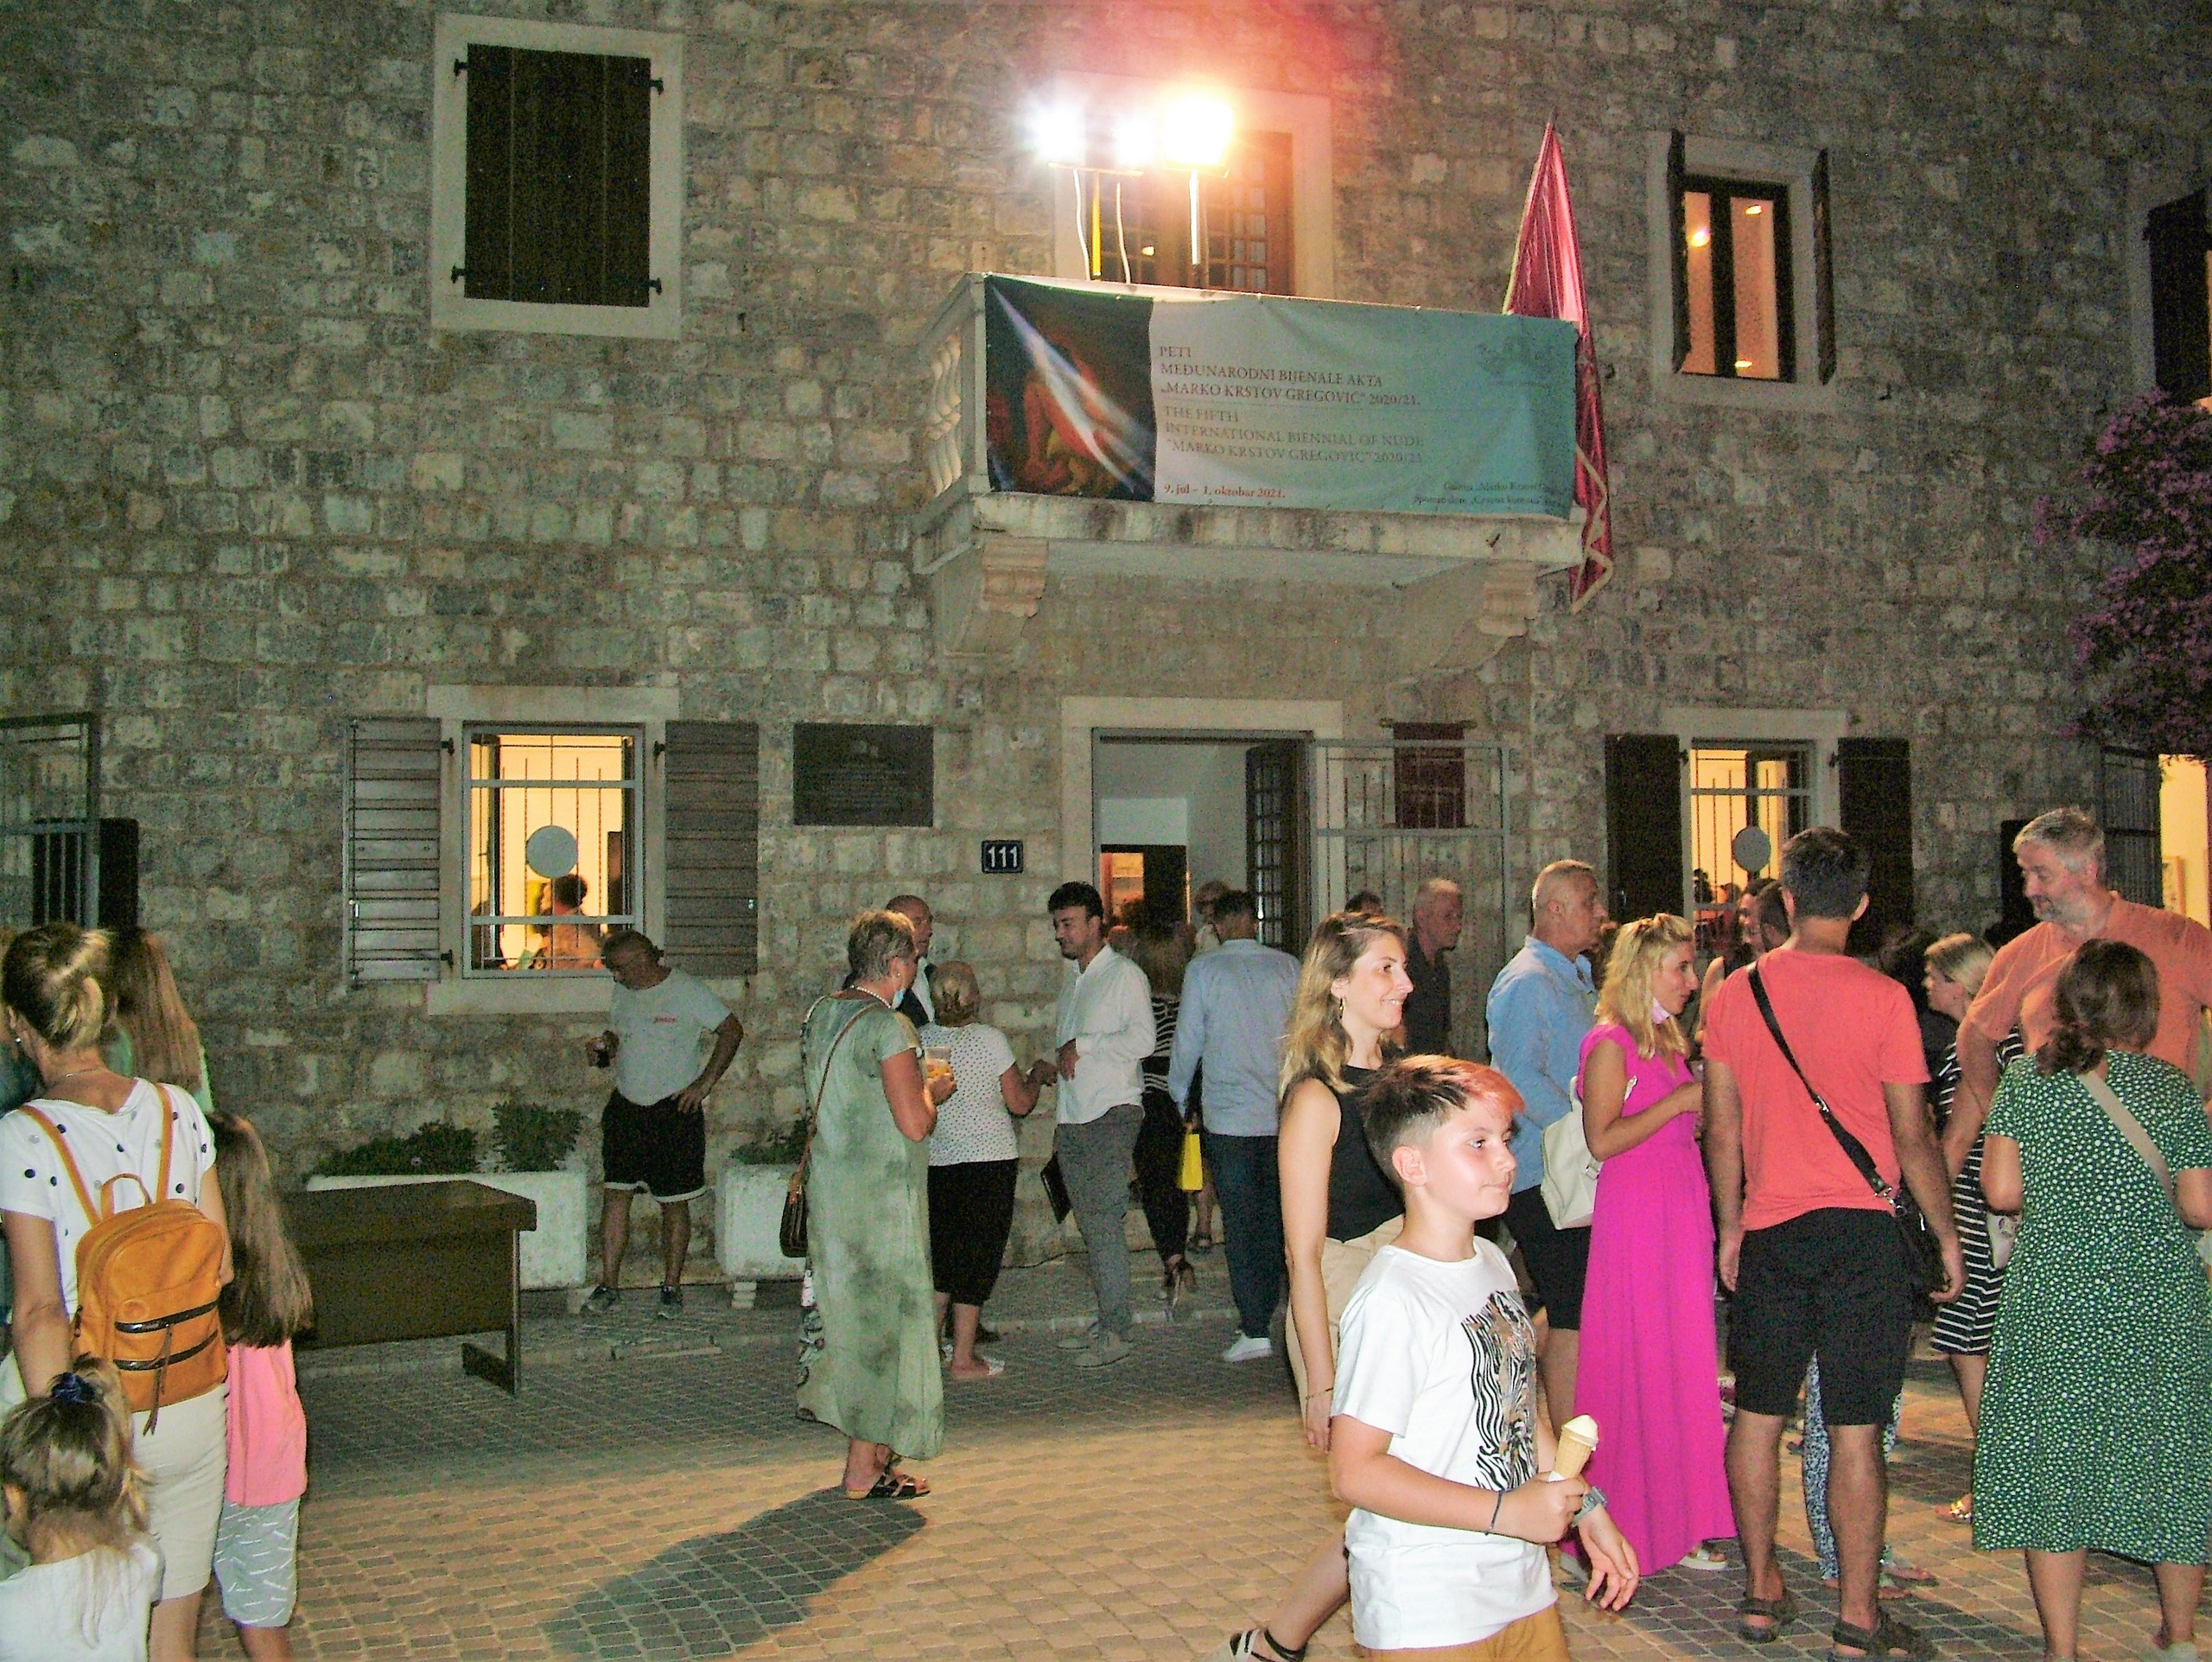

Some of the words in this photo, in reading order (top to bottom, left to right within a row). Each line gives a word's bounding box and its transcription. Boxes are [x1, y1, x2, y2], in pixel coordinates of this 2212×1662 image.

[1160, 346, 1192, 358] PETI
[1347, 373, 1382, 387] AKTA
[1224, 384, 1283, 398] KRSTOV
[1163, 405, 1191, 419] THE
[1196, 407, 1239, 422] FIFTH
[988, 846, 1018, 868] 111
